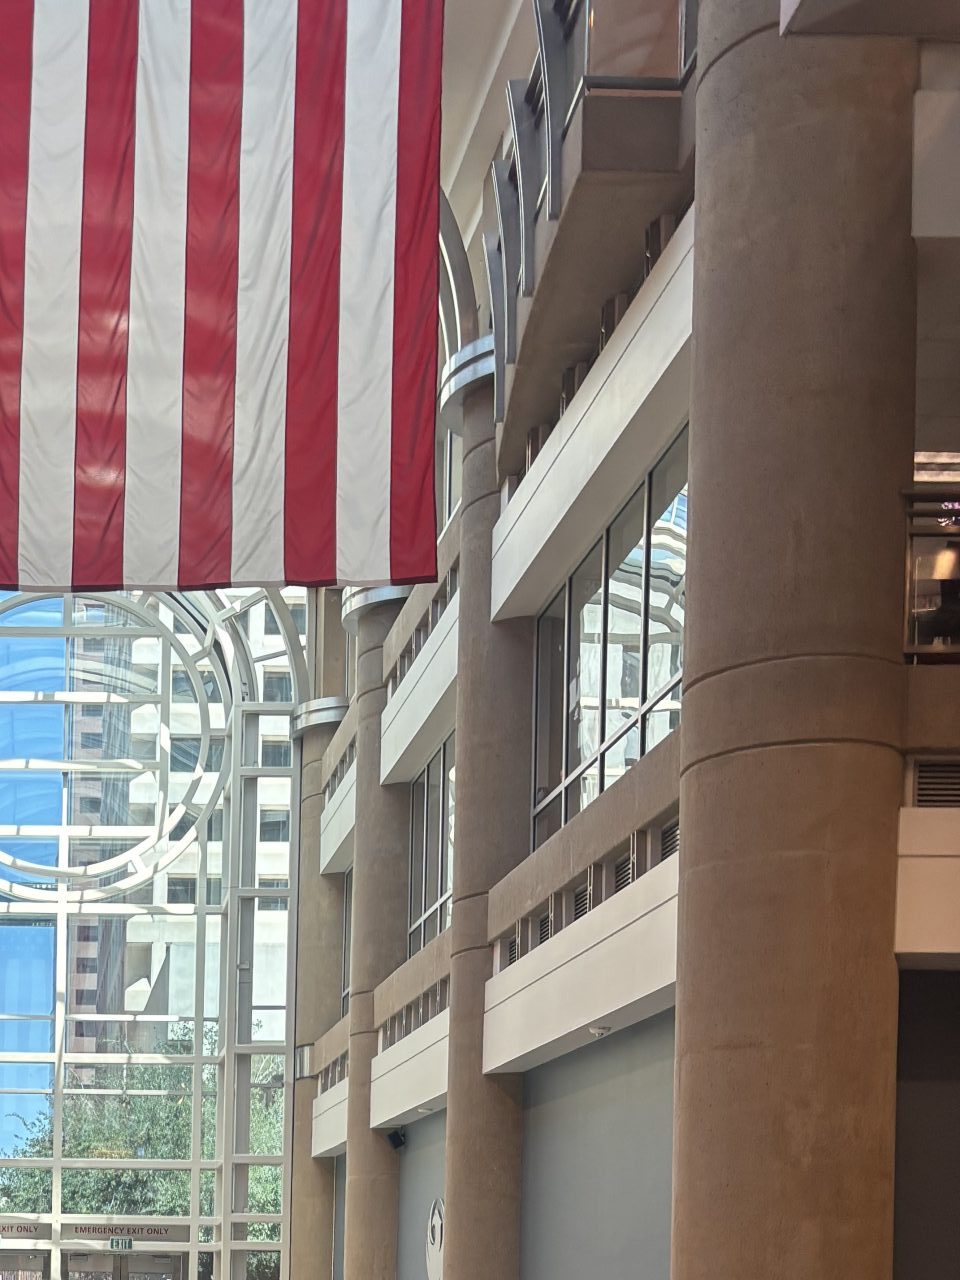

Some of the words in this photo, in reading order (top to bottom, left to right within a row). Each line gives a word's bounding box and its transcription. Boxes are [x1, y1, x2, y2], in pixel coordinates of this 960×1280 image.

[16, 1225, 39, 1233] ONLY
[74, 1226, 125, 1234] EMERGENCY
[127, 1227, 145, 1235] EXIT
[113, 1239, 130, 1249] EXIT
